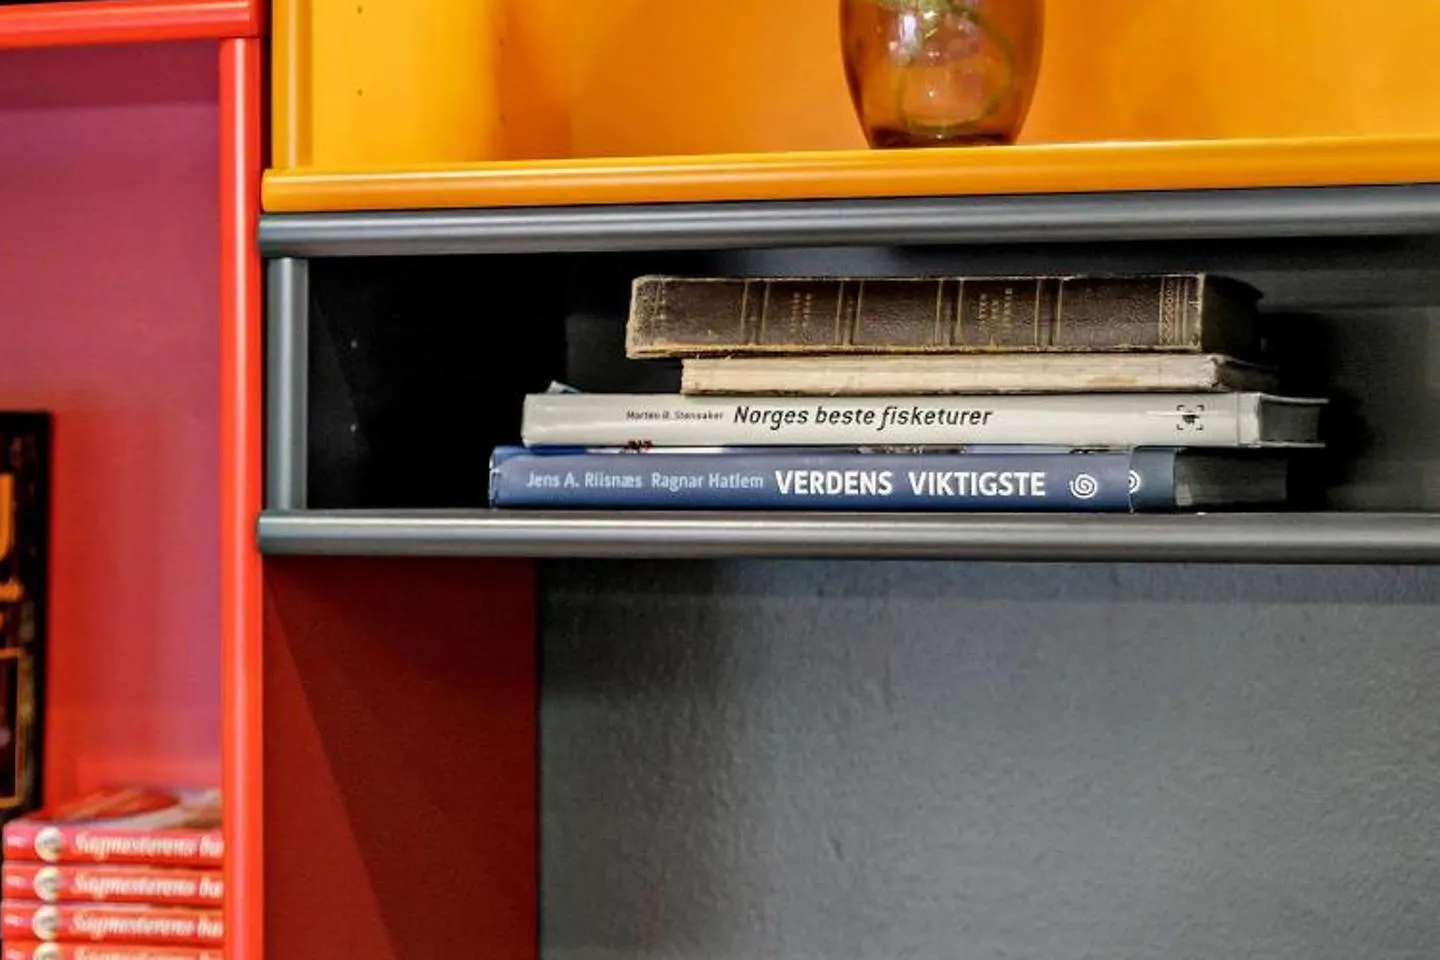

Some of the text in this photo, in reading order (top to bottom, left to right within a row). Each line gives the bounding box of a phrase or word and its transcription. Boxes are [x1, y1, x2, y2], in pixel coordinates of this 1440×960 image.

[732, 405, 994, 431] Norges beste fisketurer
[526, 471, 560, 488] Jens
[563, 471, 580, 488] A.
[651, 471, 703, 491] Ragnar
[709, 471, 764, 488] Hatlem
[774, 470, 1048, 497] VERDENS VIKTIGSTE
